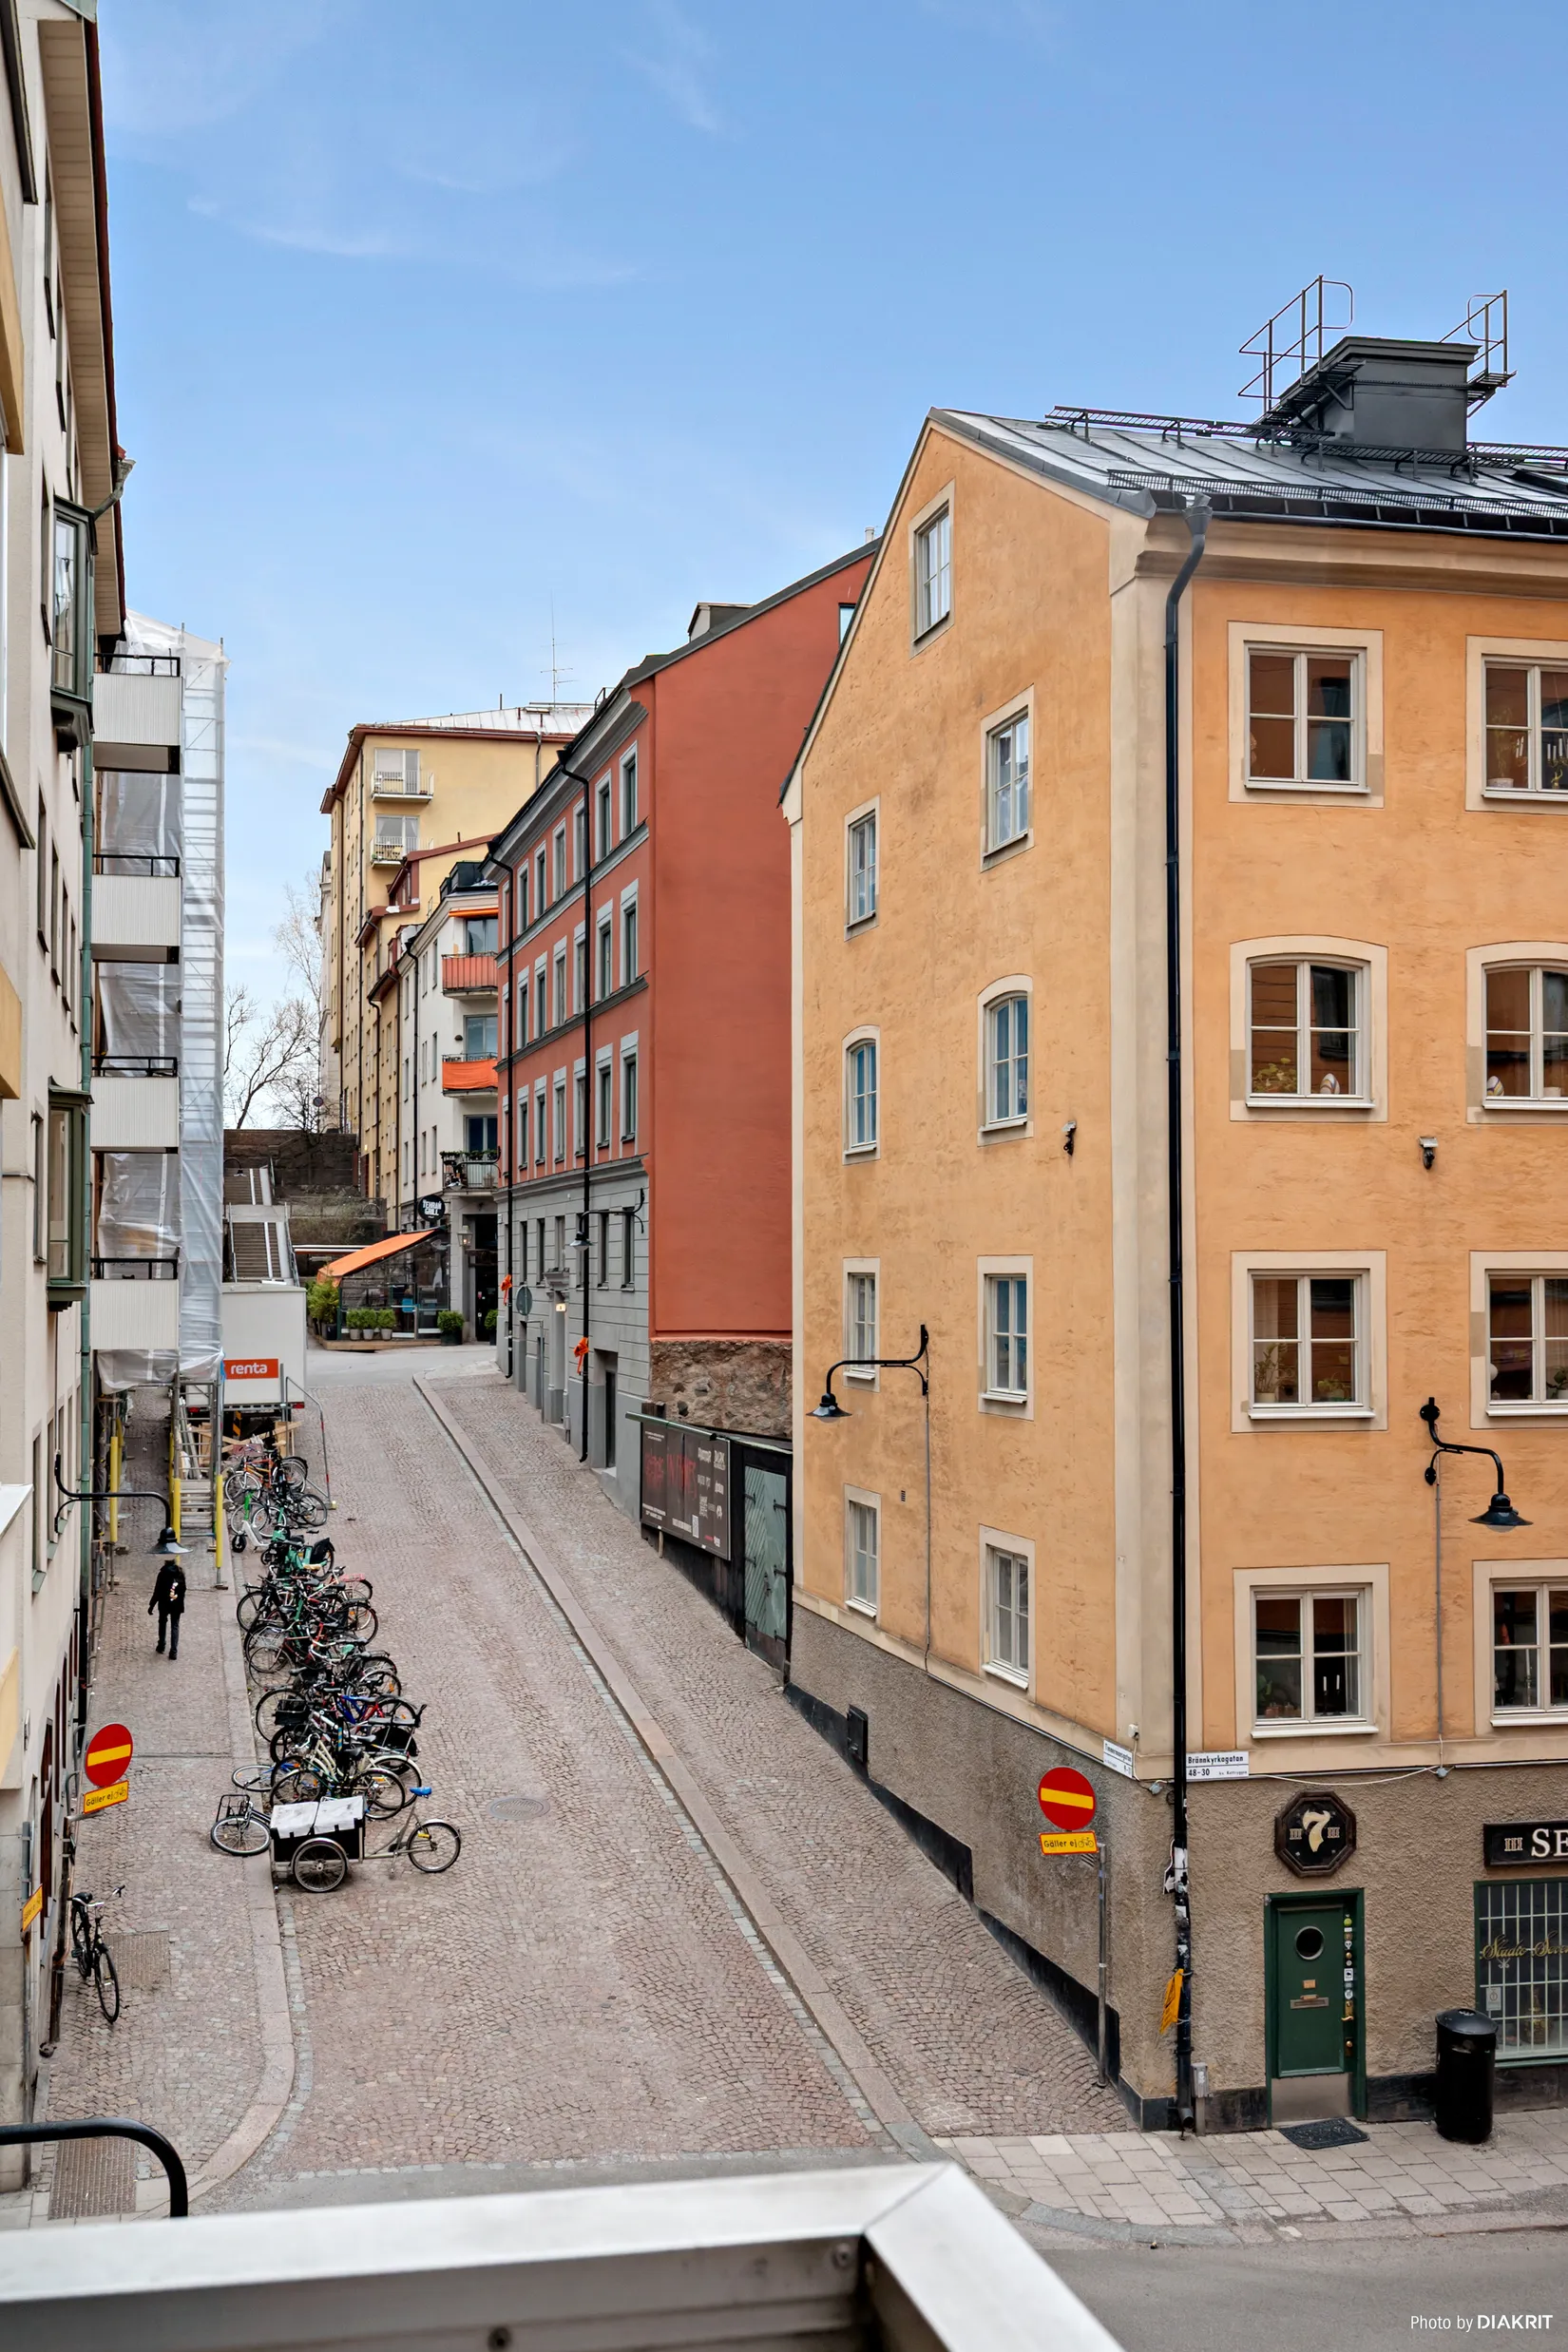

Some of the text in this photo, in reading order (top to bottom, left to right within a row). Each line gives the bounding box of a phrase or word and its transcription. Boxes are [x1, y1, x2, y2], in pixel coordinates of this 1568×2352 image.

[230, 1363, 268, 1374] renta
[1188, 1755, 1243, 1765] Brännkyrkagatan
[86, 1791, 113, 1806] Gäller ej
[1302, 1808, 1330, 1852] 7
[1043, 1839, 1078, 1848] Gäller ej
